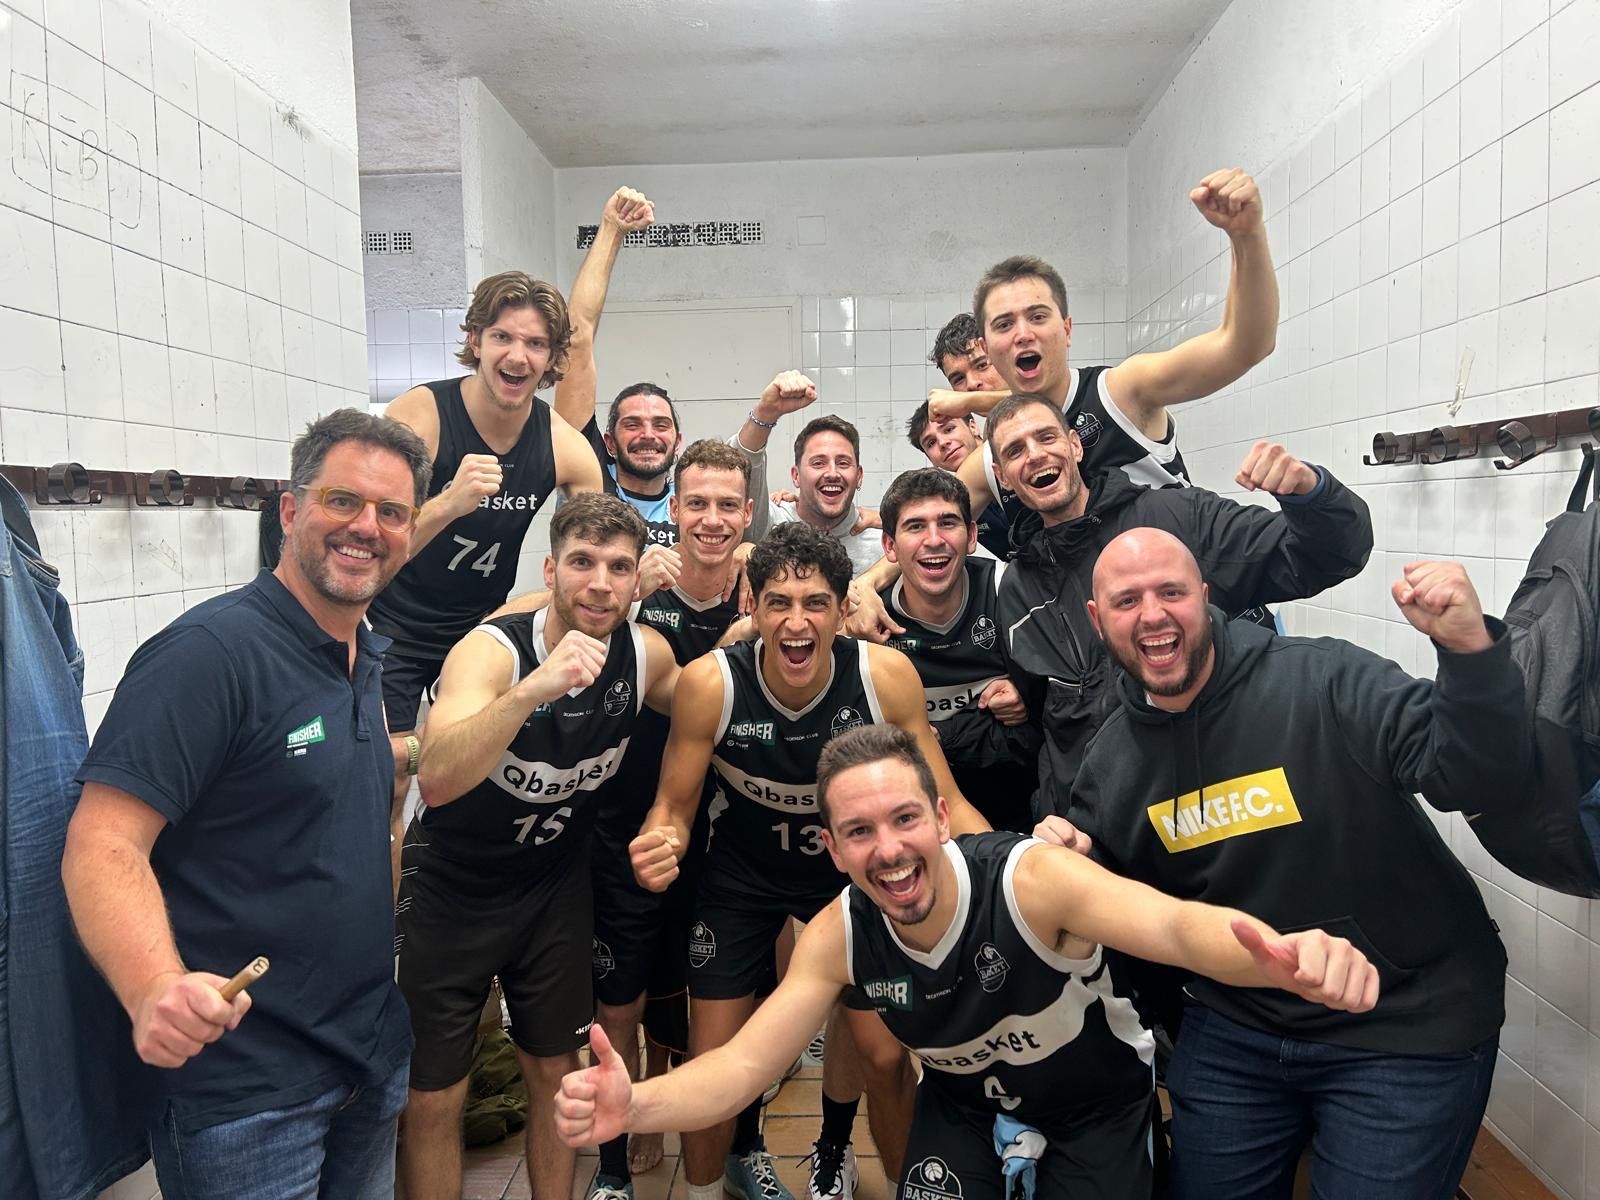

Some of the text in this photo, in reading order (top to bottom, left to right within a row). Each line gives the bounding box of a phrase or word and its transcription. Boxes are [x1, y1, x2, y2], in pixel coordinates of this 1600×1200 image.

[1079, 422, 1100, 439] SKET
[646, 526, 676, 543] ket
[447, 534, 502, 578] 74
[642, 609, 680, 628] FINISHER
[288, 721, 322, 745] FINISHER
[743, 780, 815, 806] Qbas
[512, 806, 573, 846] 15
[771, 822, 827, 856] 13
[864, 981, 909, 1005] NISHER
